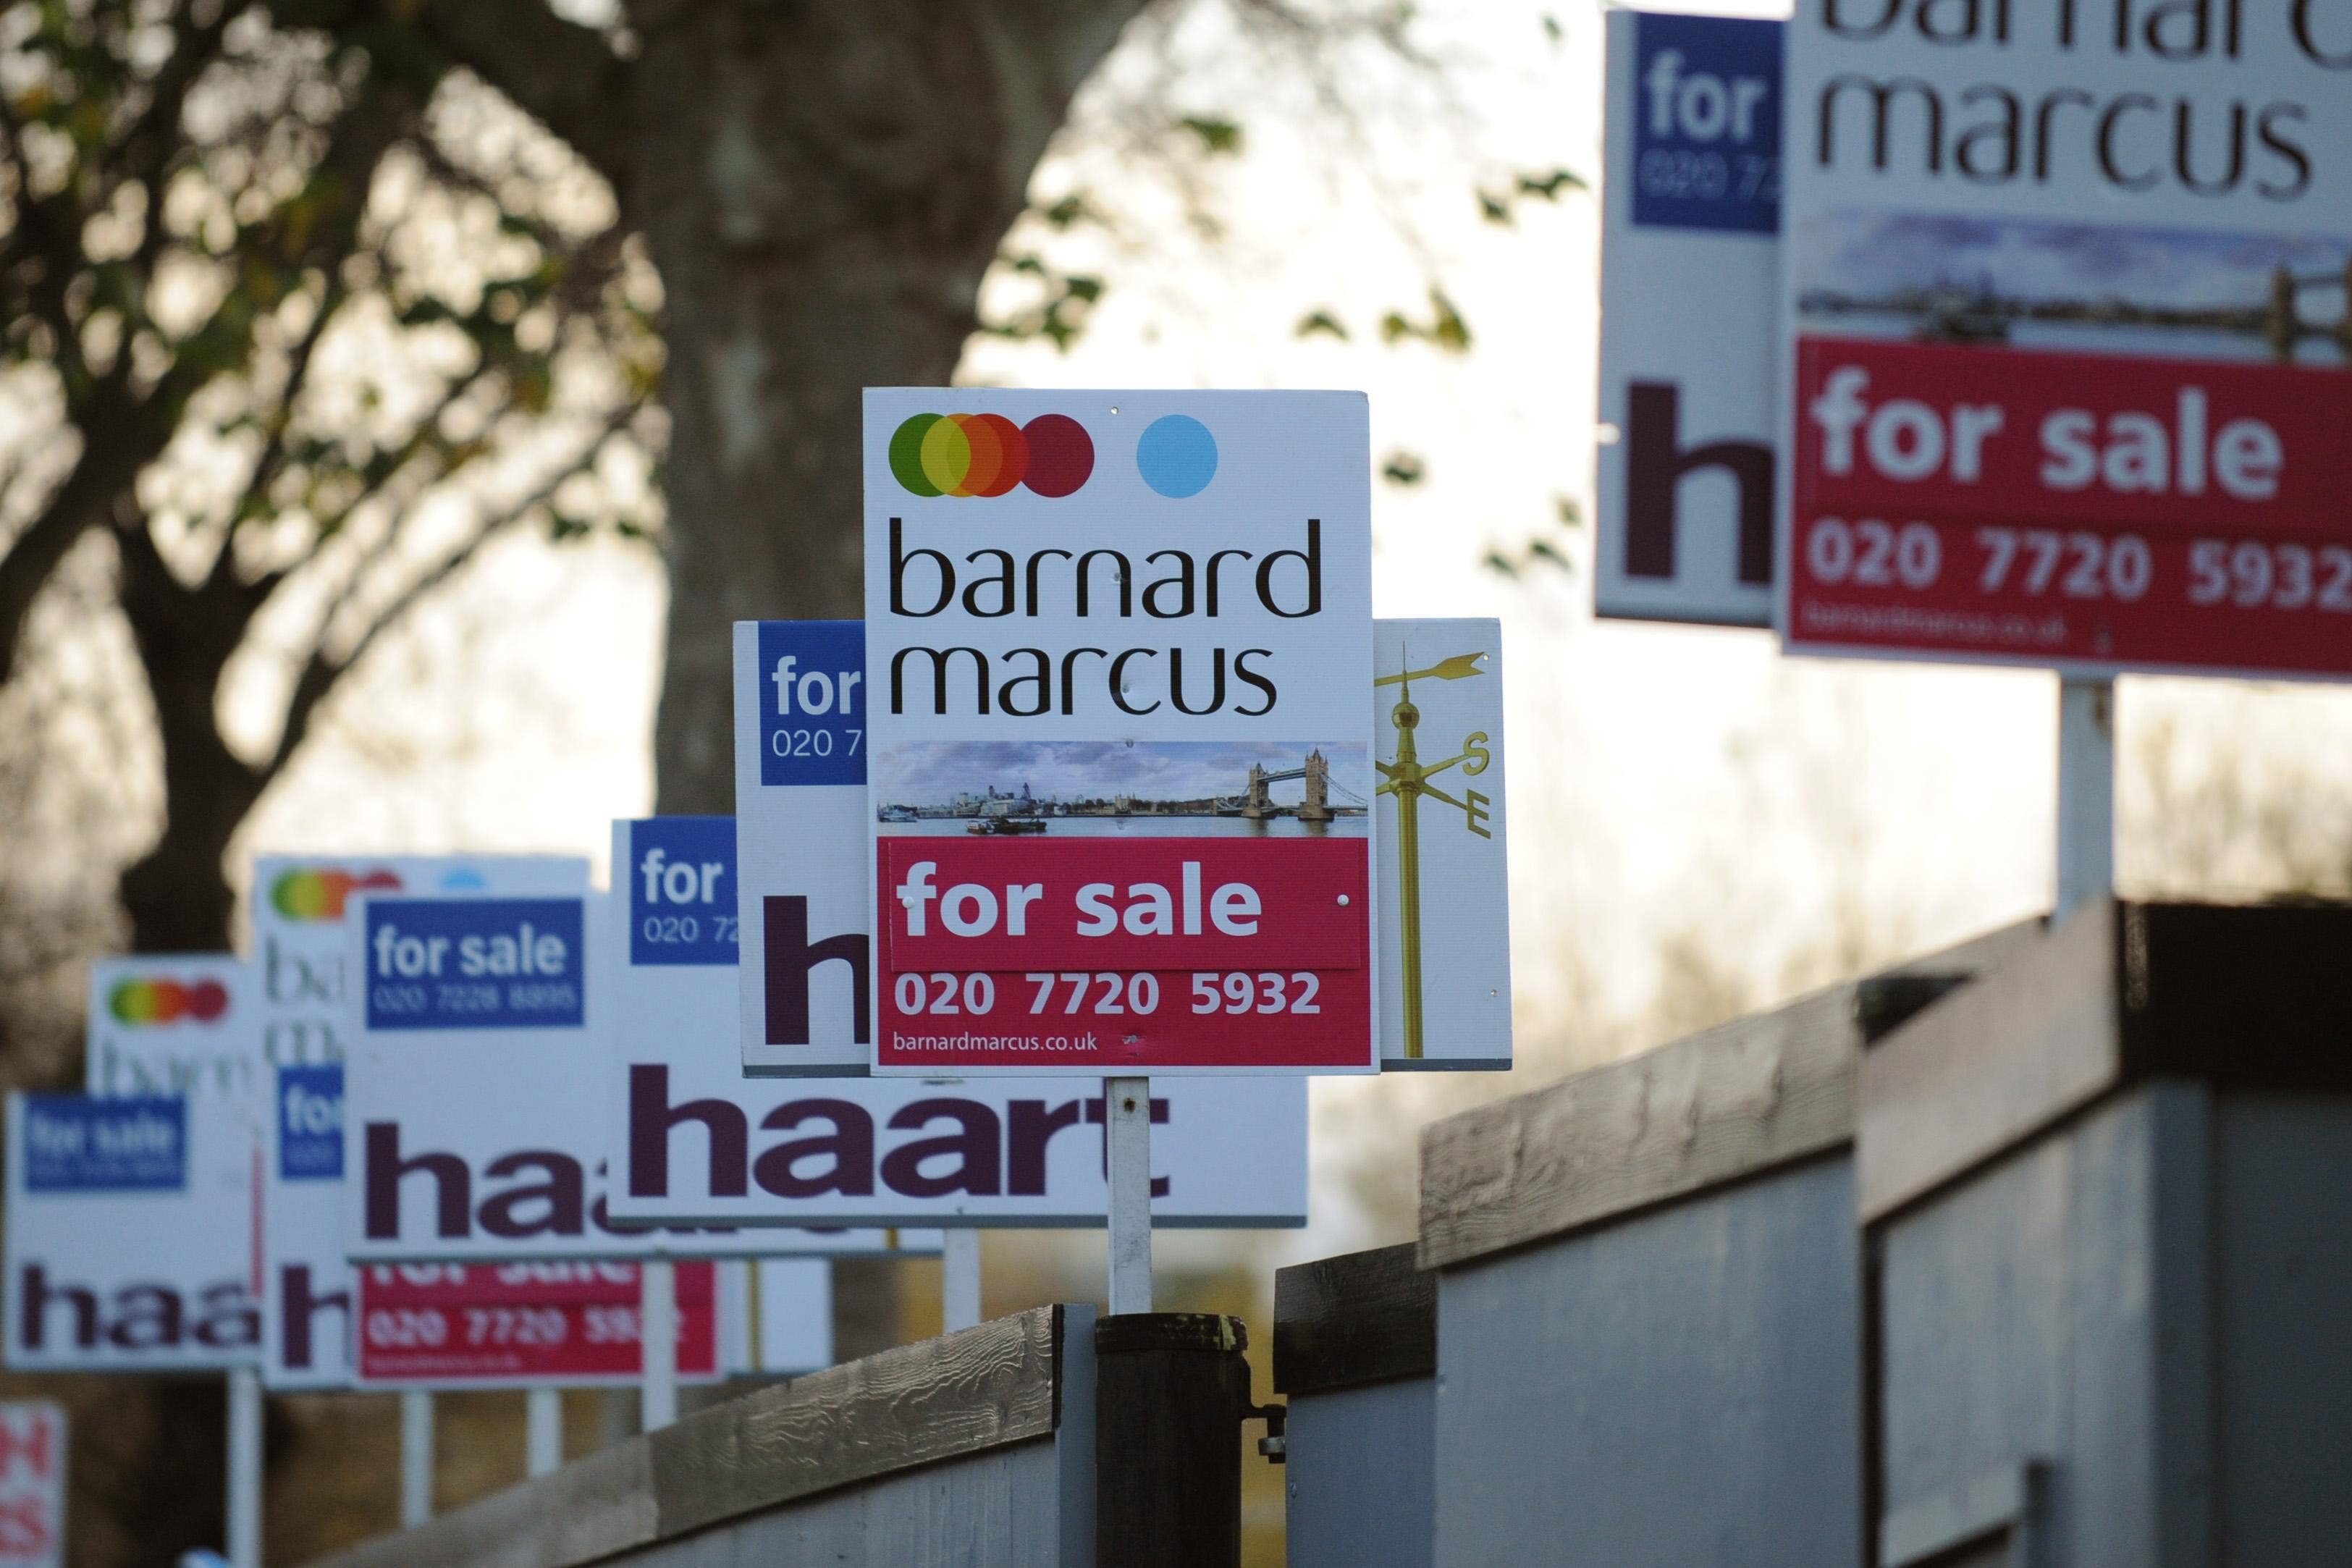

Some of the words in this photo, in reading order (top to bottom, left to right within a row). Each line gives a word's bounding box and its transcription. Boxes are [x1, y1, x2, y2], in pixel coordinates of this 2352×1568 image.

[1647, 49, 1767, 142] for
[1817, 73, 2313, 203] marcus
[1811, 365, 2005, 483] for
[2039, 386, 2285, 501] sale
[890, 517, 1322, 618] barnard
[1807, 517, 1942, 589] 020
[1975, 526, 2154, 602] 7720
[2188, 537, 2352, 613] 5932
[772, 655, 861, 716] for
[890, 646, 1278, 717] marcus
[772, 729, 833, 757] 020
[845, 729, 862, 756] 7
[641, 847, 725, 904] for
[896, 861, 1043, 937] for
[1075, 861, 1262, 937] sale
[375, 923, 450, 977] for
[459, 920, 568, 977] sale
[644, 916, 699, 943] 020
[894, 972, 995, 1015] 020
[1025, 972, 1160, 1015] 7720
[1192, 972, 1320, 1015] 5932
[893, 1032, 1097, 1051] barnardmarcus.co.uk
[367, 1308, 448, 1347] 020
[463, 1307, 569, 1346] 7720
